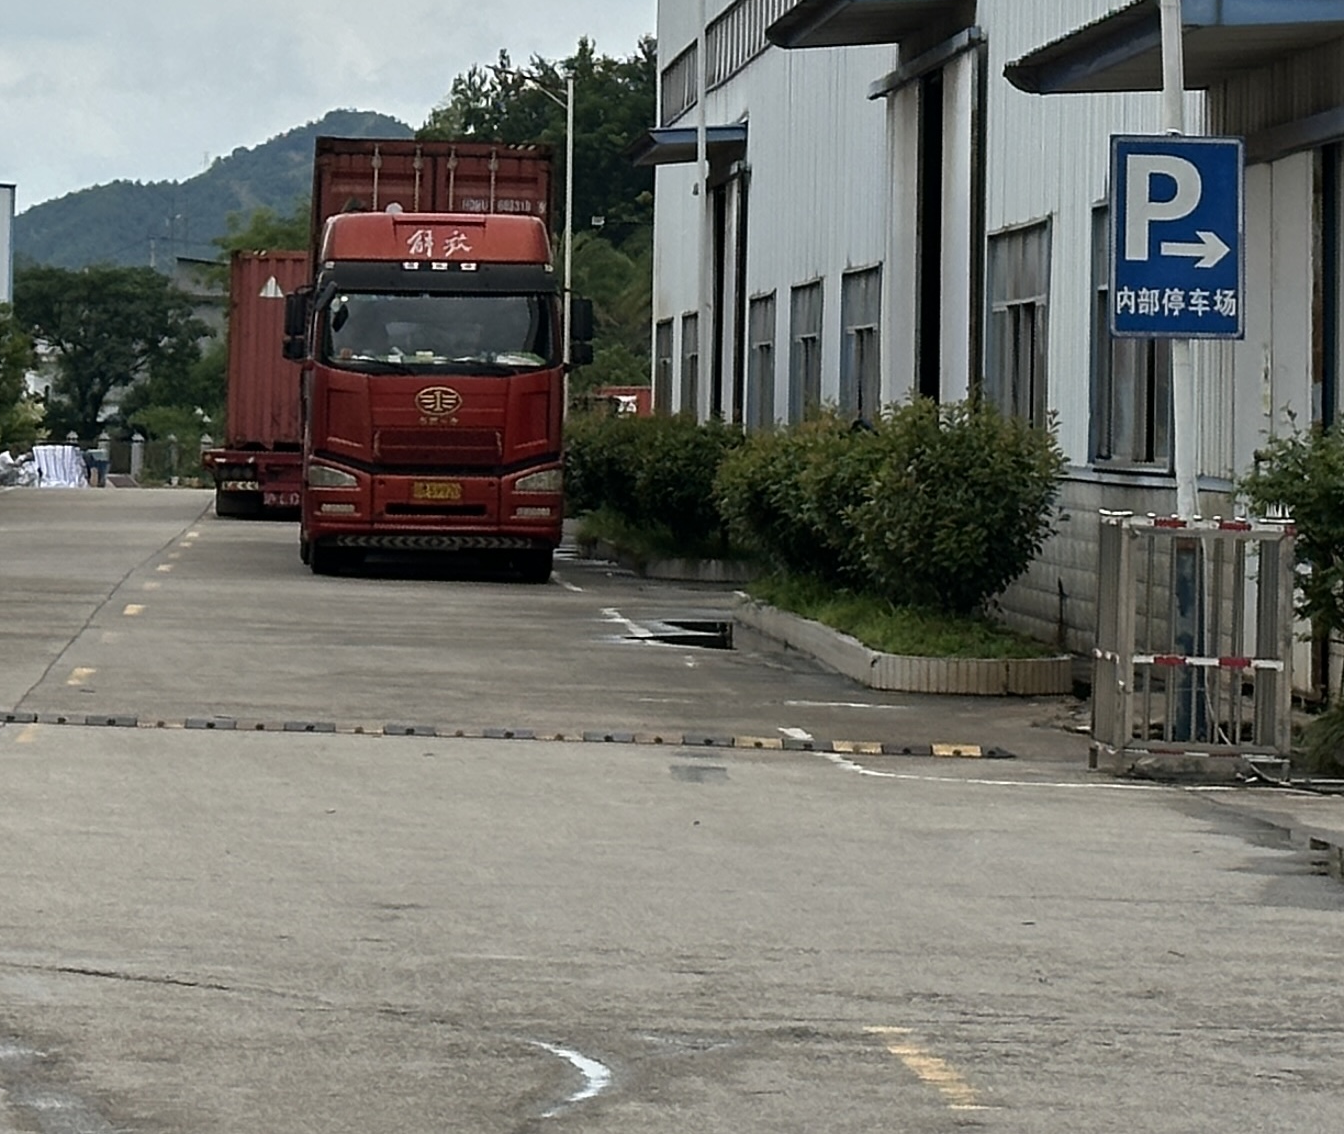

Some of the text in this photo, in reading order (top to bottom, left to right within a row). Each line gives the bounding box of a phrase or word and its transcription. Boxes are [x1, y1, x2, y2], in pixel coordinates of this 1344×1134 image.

[1125, 153, 1202, 261] P
[406, 230, 472, 257] 解放
[1116, 286, 1236, 316] 内部停车场
